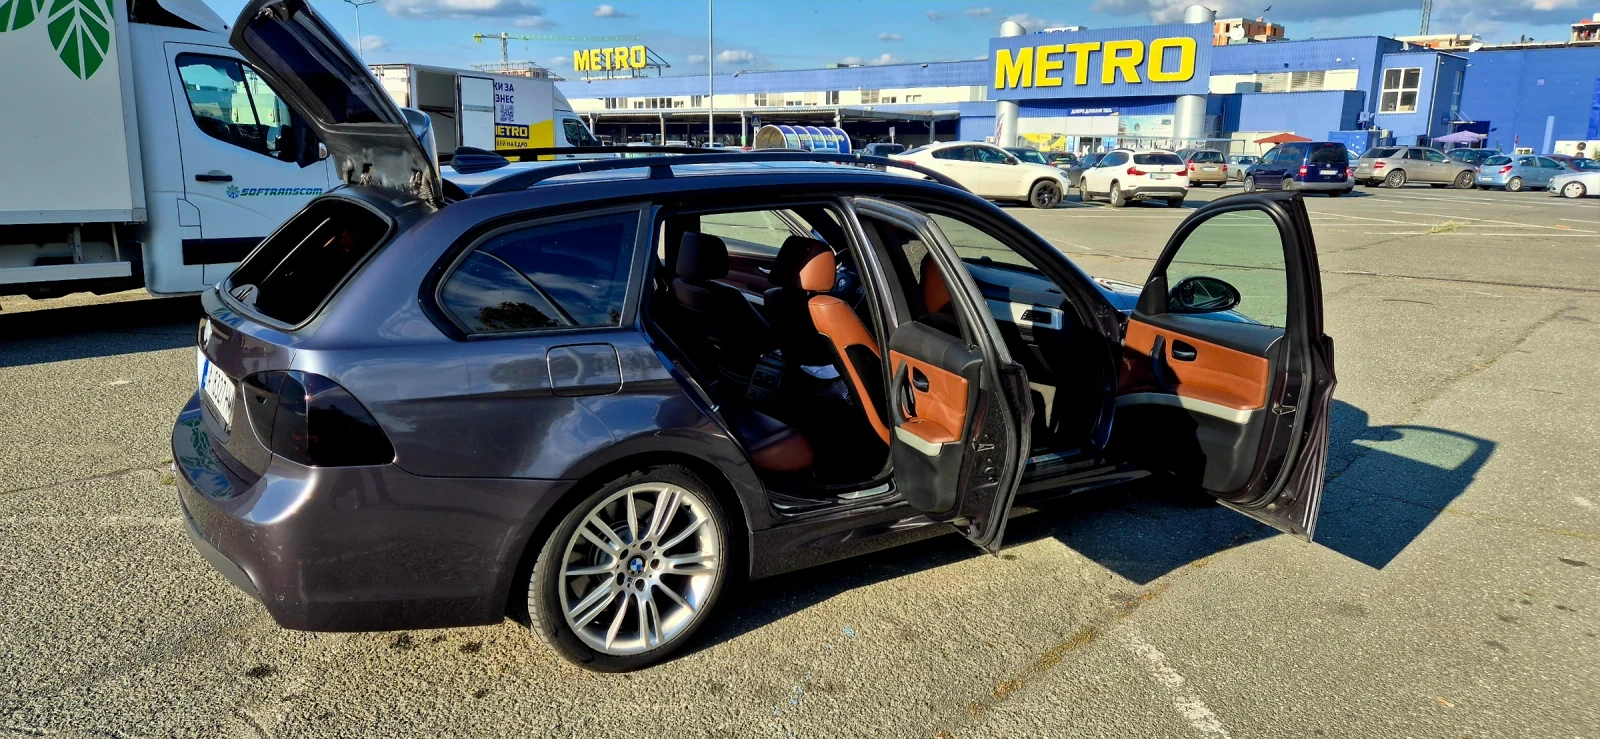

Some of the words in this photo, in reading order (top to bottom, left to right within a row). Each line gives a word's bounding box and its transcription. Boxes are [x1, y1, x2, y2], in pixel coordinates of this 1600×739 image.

[573, 45, 647, 71] METRO
[994, 37, 1197, 89] METRO
[505, 83, 514, 92] ЗА
[240, 188, 323, 196] SOFTRANSCOM
